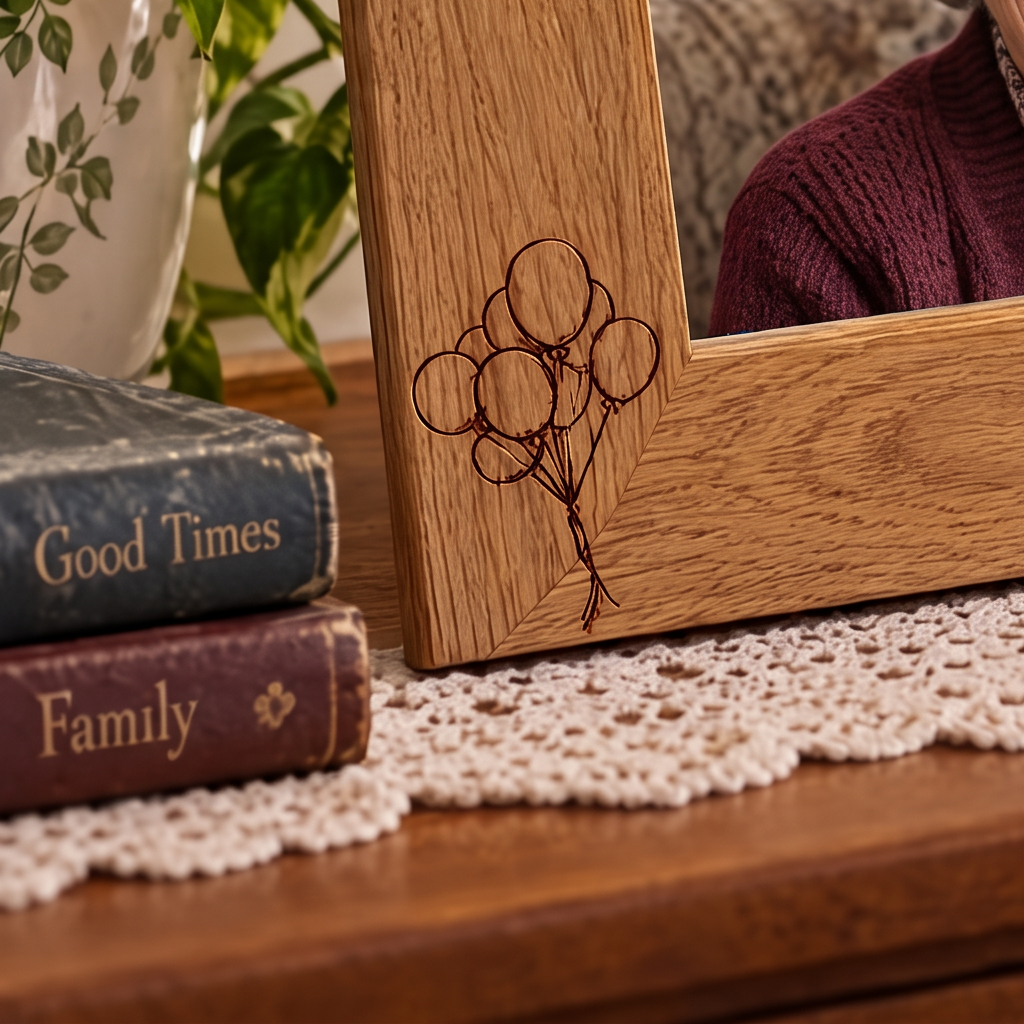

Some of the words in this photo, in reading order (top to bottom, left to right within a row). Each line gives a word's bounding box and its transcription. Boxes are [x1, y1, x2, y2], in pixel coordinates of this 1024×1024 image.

[34, 516, 148, 586] Good
[161, 511, 282, 565] Times
[36, 679, 199, 761] Family
